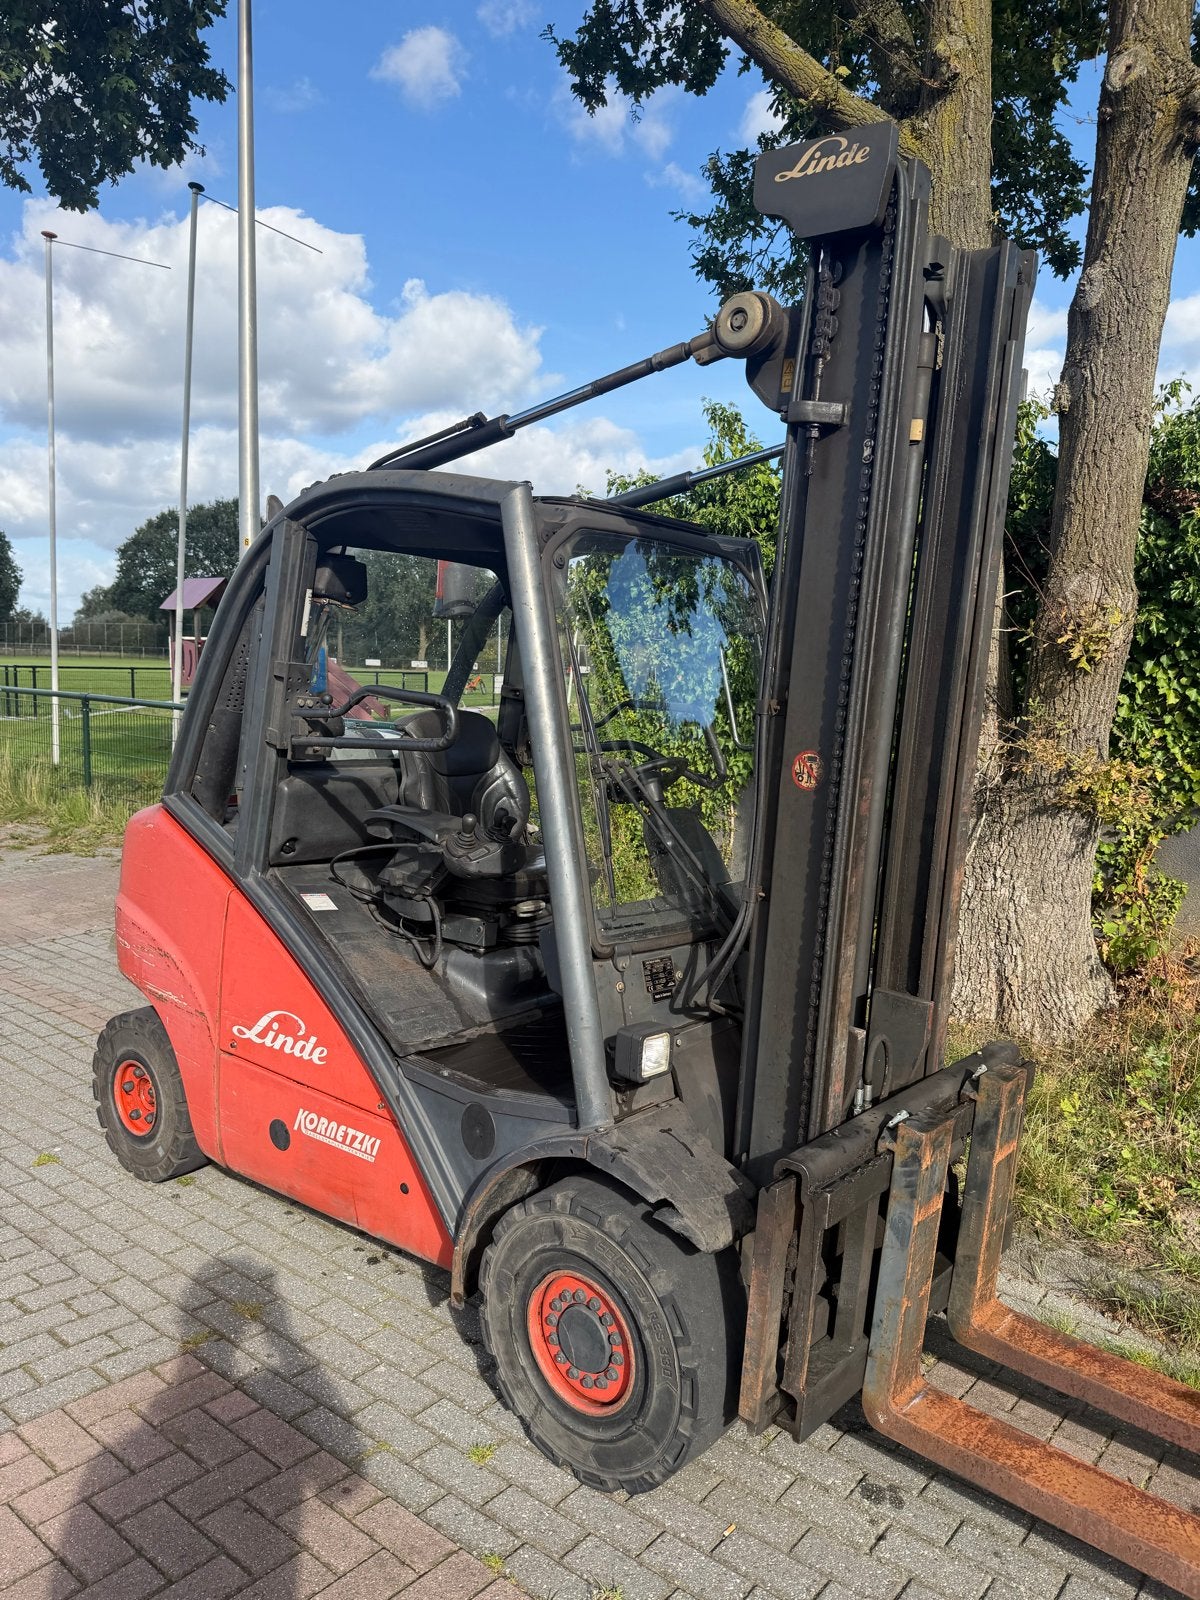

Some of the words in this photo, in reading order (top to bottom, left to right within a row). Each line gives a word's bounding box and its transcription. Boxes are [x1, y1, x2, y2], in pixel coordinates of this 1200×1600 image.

[774, 136, 871, 183] Linde
[232, 1010, 328, 1065] Linde
[293, 1108, 381, 1157] KORNETZKI
